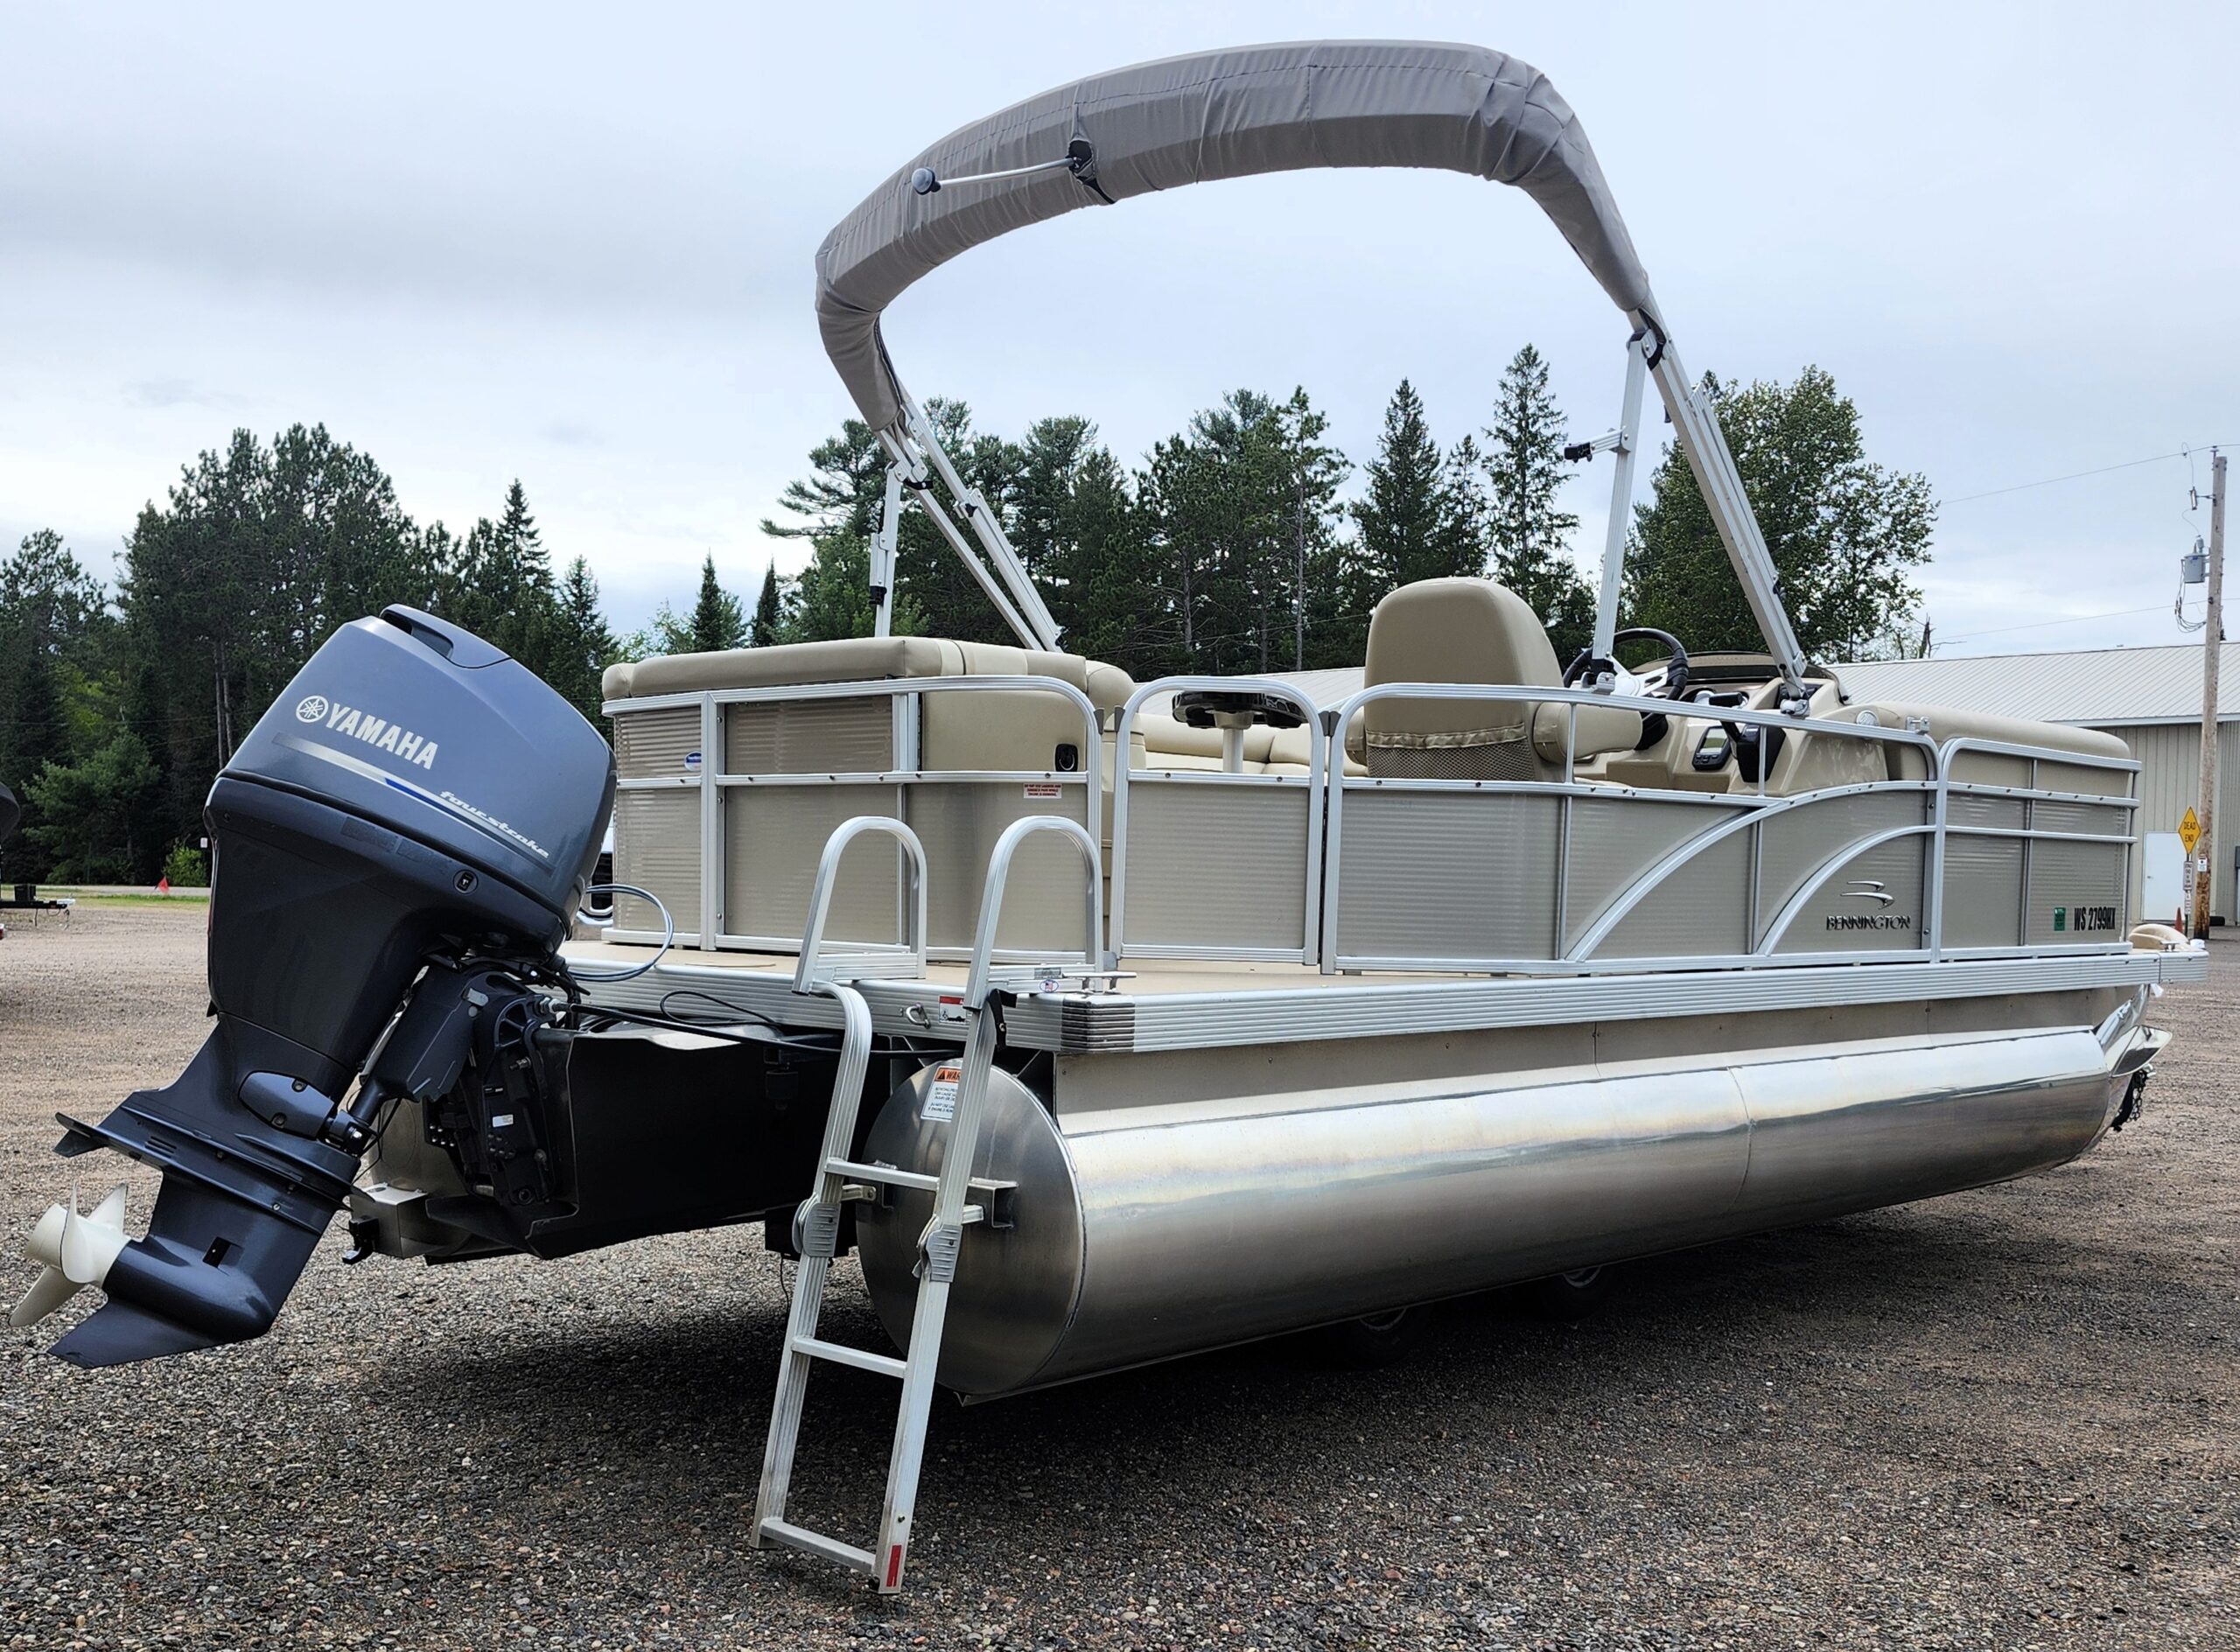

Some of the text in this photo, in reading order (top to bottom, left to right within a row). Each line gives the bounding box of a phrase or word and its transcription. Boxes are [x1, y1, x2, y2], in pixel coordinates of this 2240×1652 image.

[326, 703, 438, 770] YAMAHA
[2183, 821, 2196, 830] DEAD
[2185, 834, 2194, 843] END
[1826, 914, 1911, 931] BENNINGTON
[2074, 906, 2086, 931] WS
